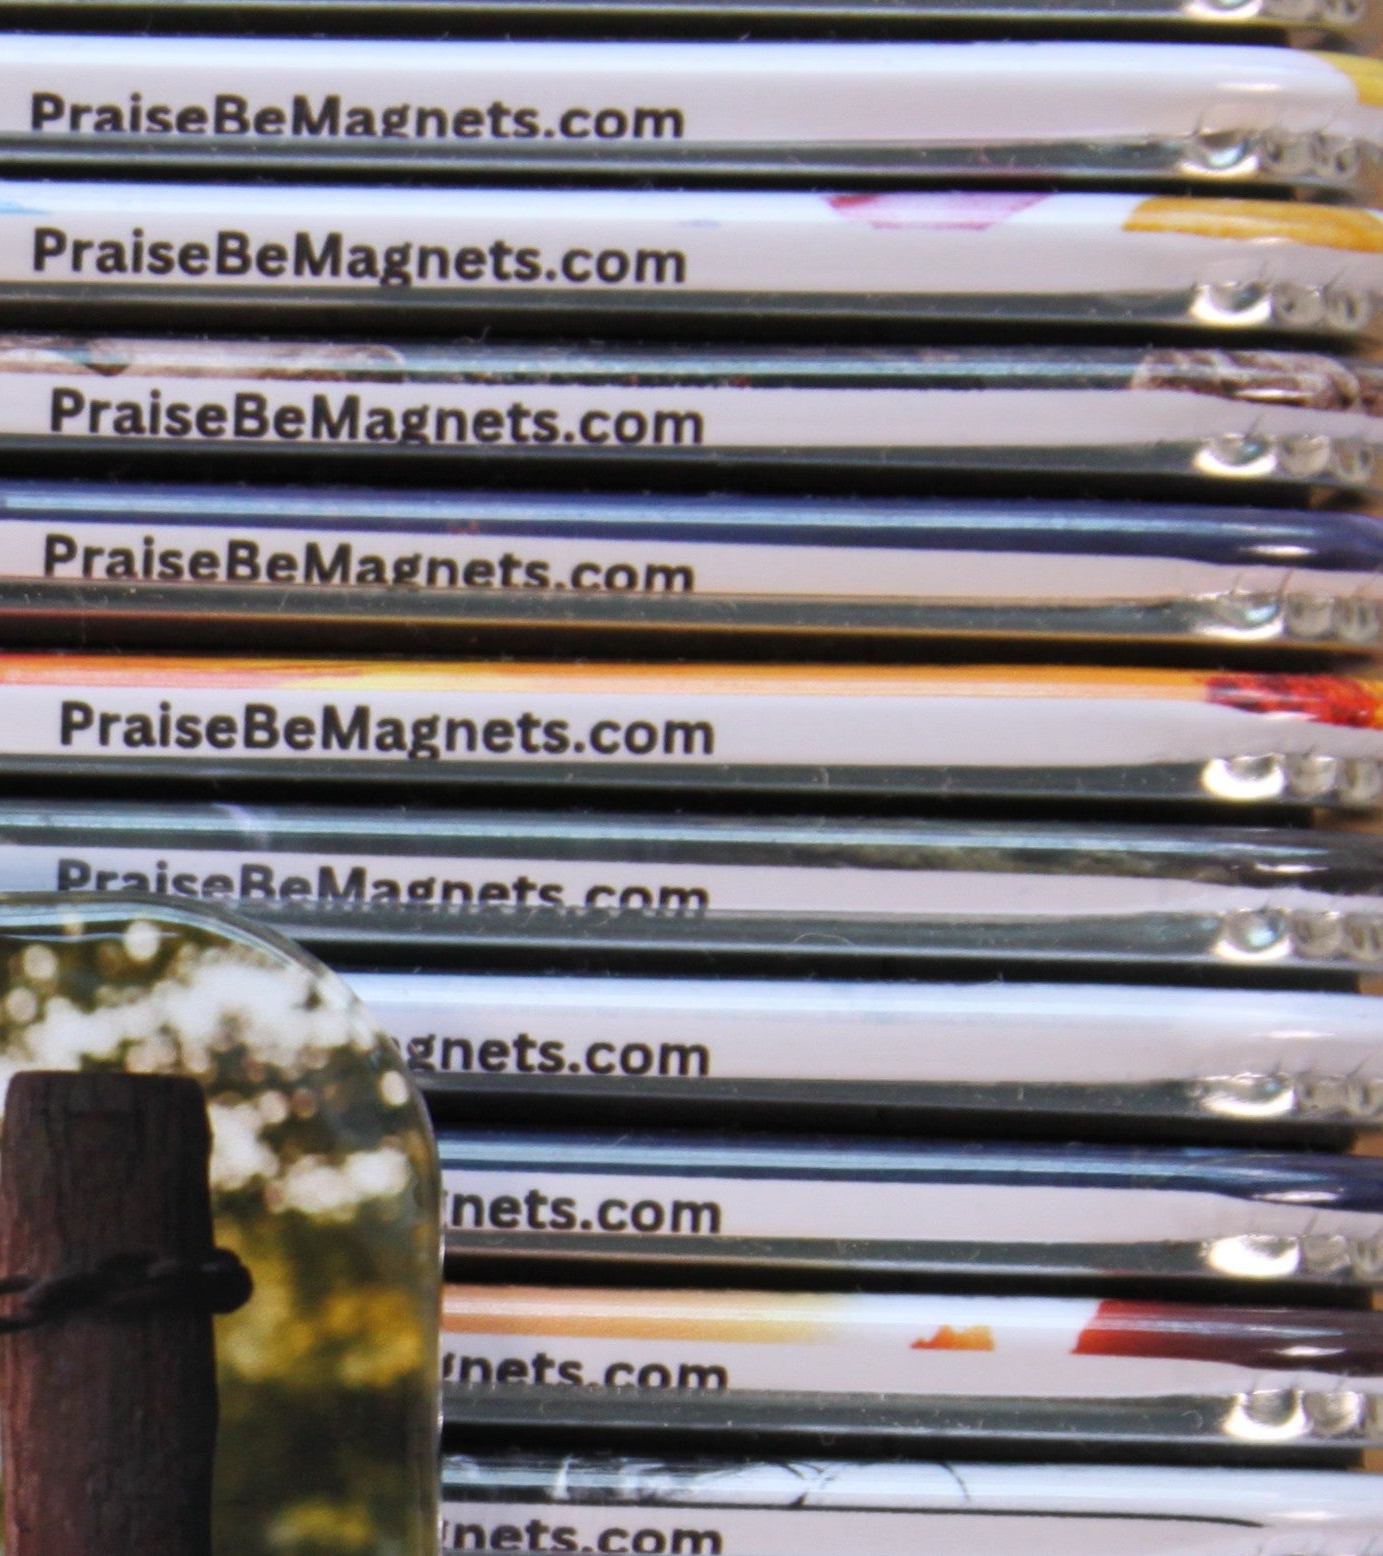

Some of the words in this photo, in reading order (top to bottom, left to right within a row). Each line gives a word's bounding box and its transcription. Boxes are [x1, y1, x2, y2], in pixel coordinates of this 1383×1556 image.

[31, 91, 685, 140] PraiseBeMagnets.com
[33, 227, 686, 286] PraiseBeMagnets.com
[49, 387, 704, 445] PraiseBeMagnets.com
[43, 534, 695, 593] PraiseBeMagnets.com
[59, 700, 715, 760] PraiseBeMagnets.com
